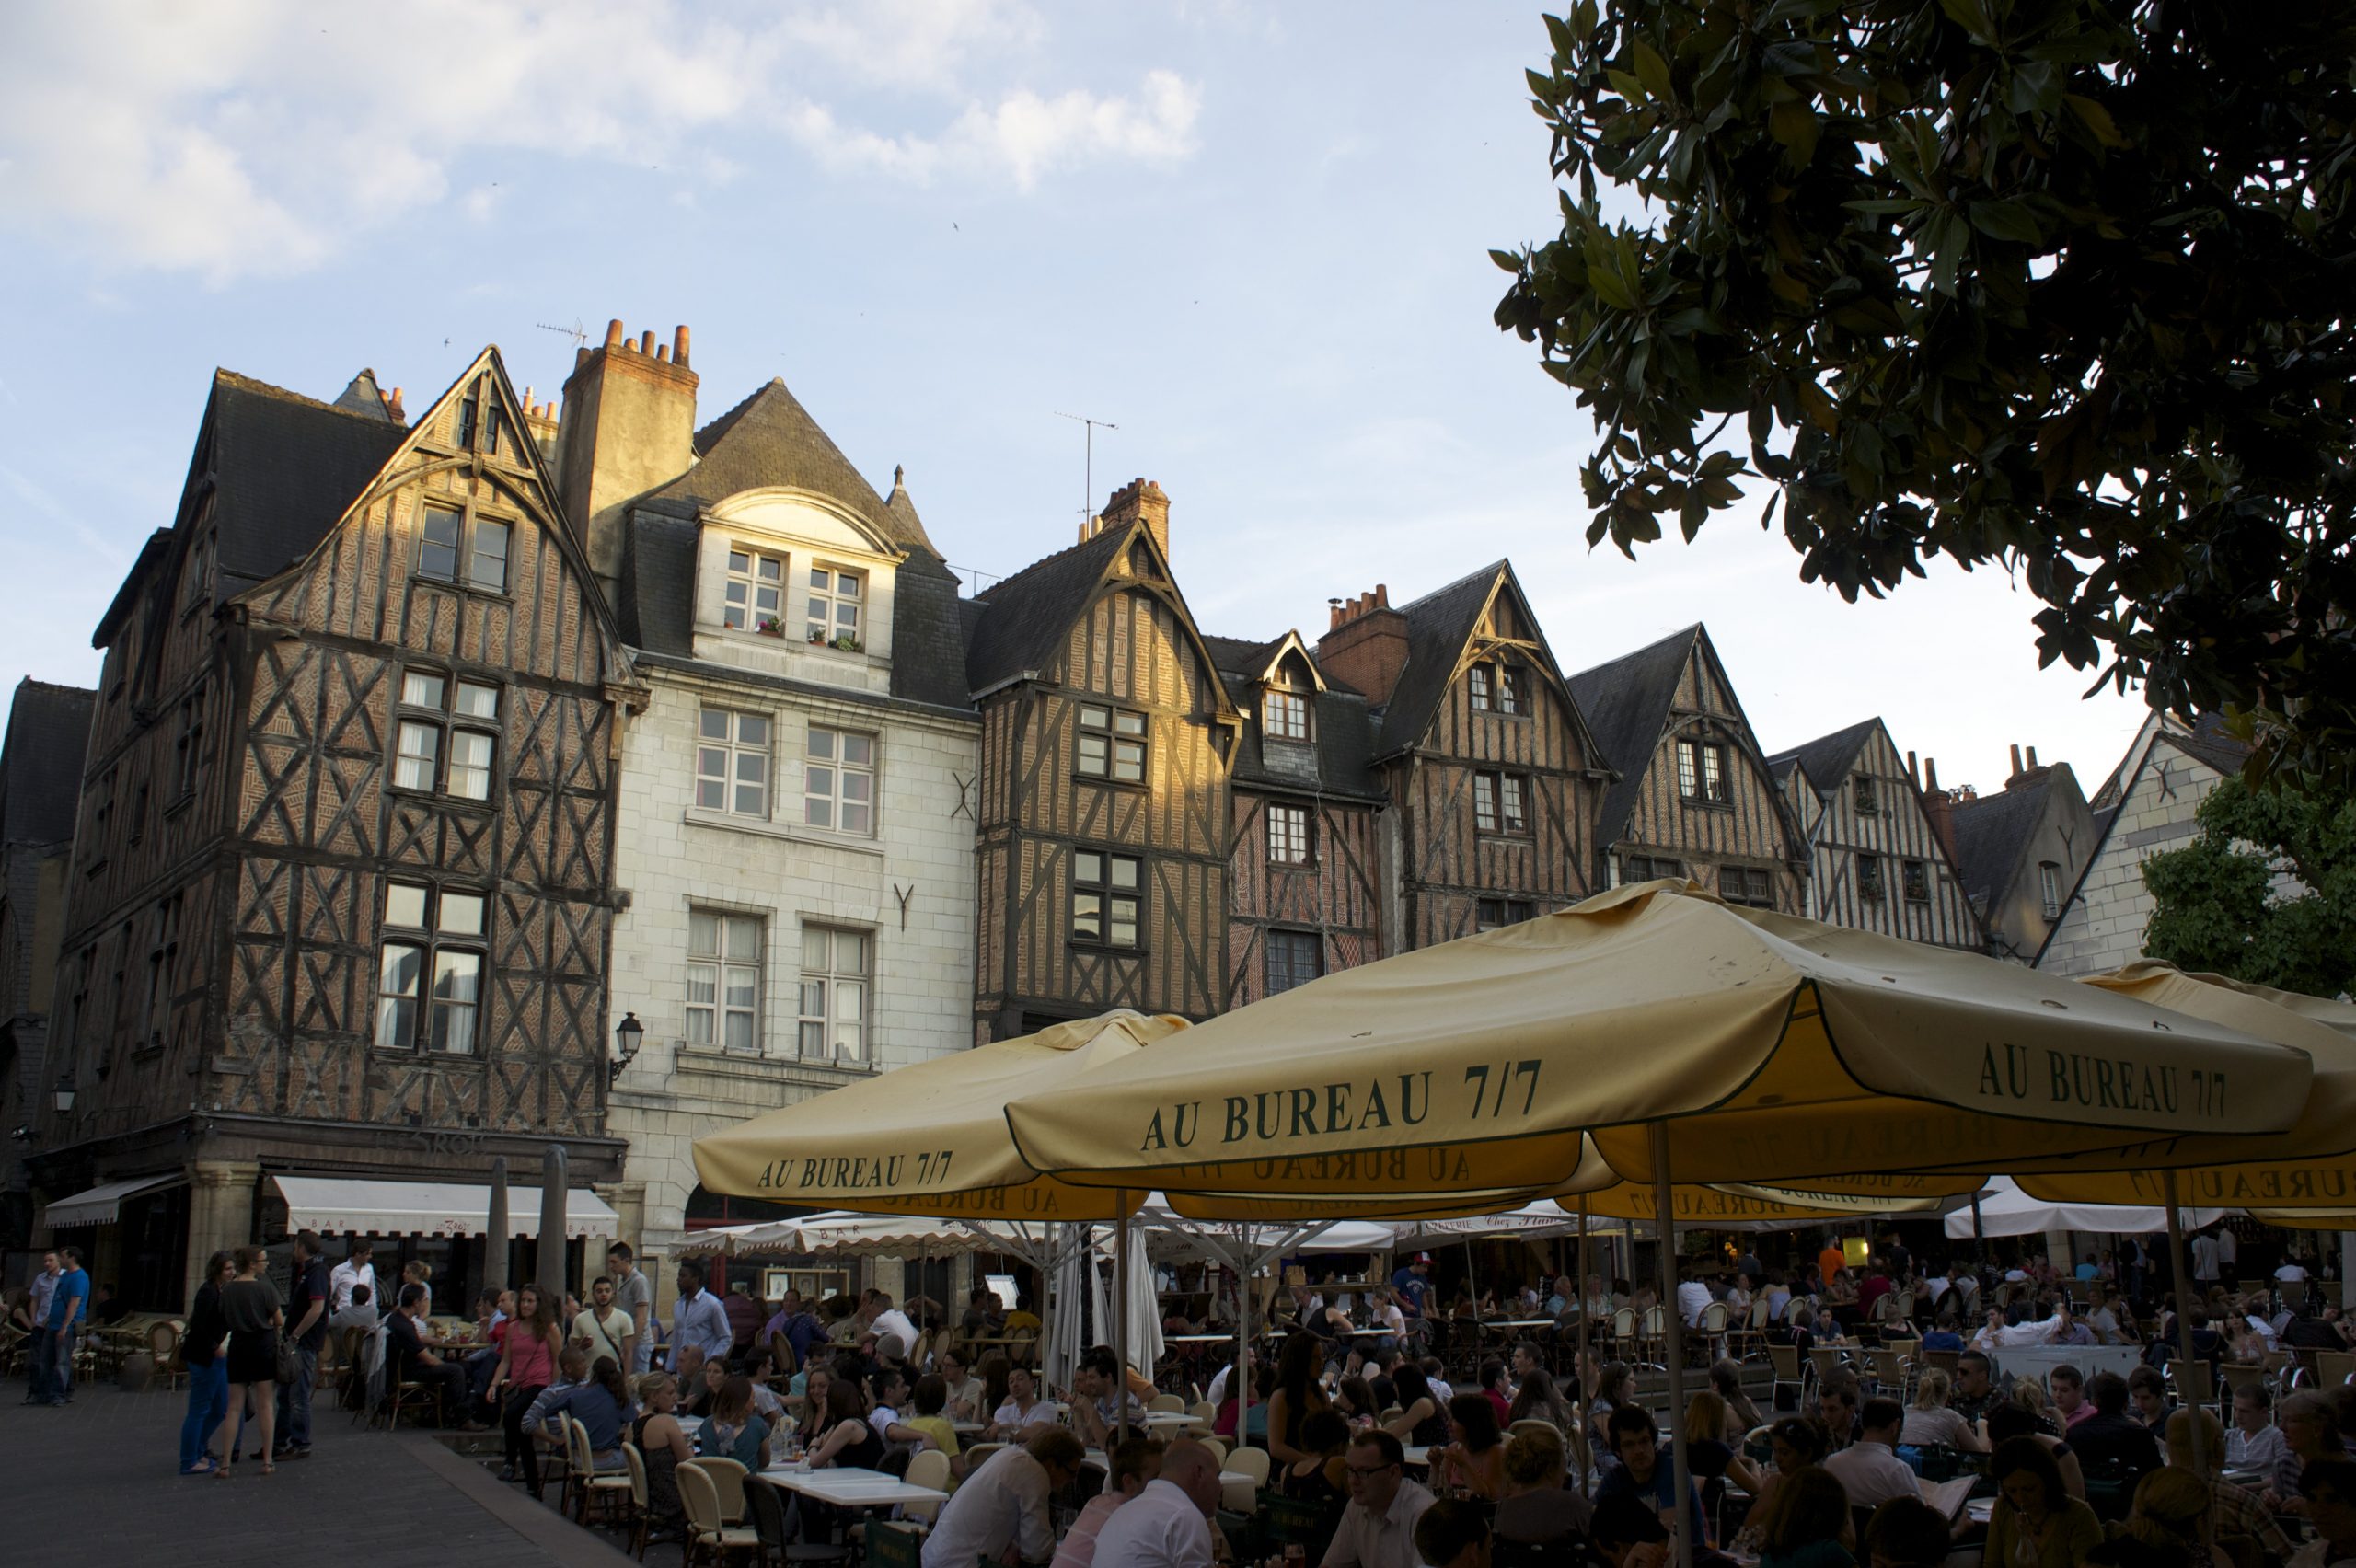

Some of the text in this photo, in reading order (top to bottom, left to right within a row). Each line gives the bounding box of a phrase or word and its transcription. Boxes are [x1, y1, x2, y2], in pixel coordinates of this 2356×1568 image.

[1979, 1042, 2225, 1118] AU BUREAU 7/7
[1140, 1059, 1542, 1151] AU BUREAU 7/7
[758, 1150, 953, 1188] AU BUREAU 7/7
[568, 1225, 597, 1233] BAR
[820, 1224, 860, 1239] BAR
